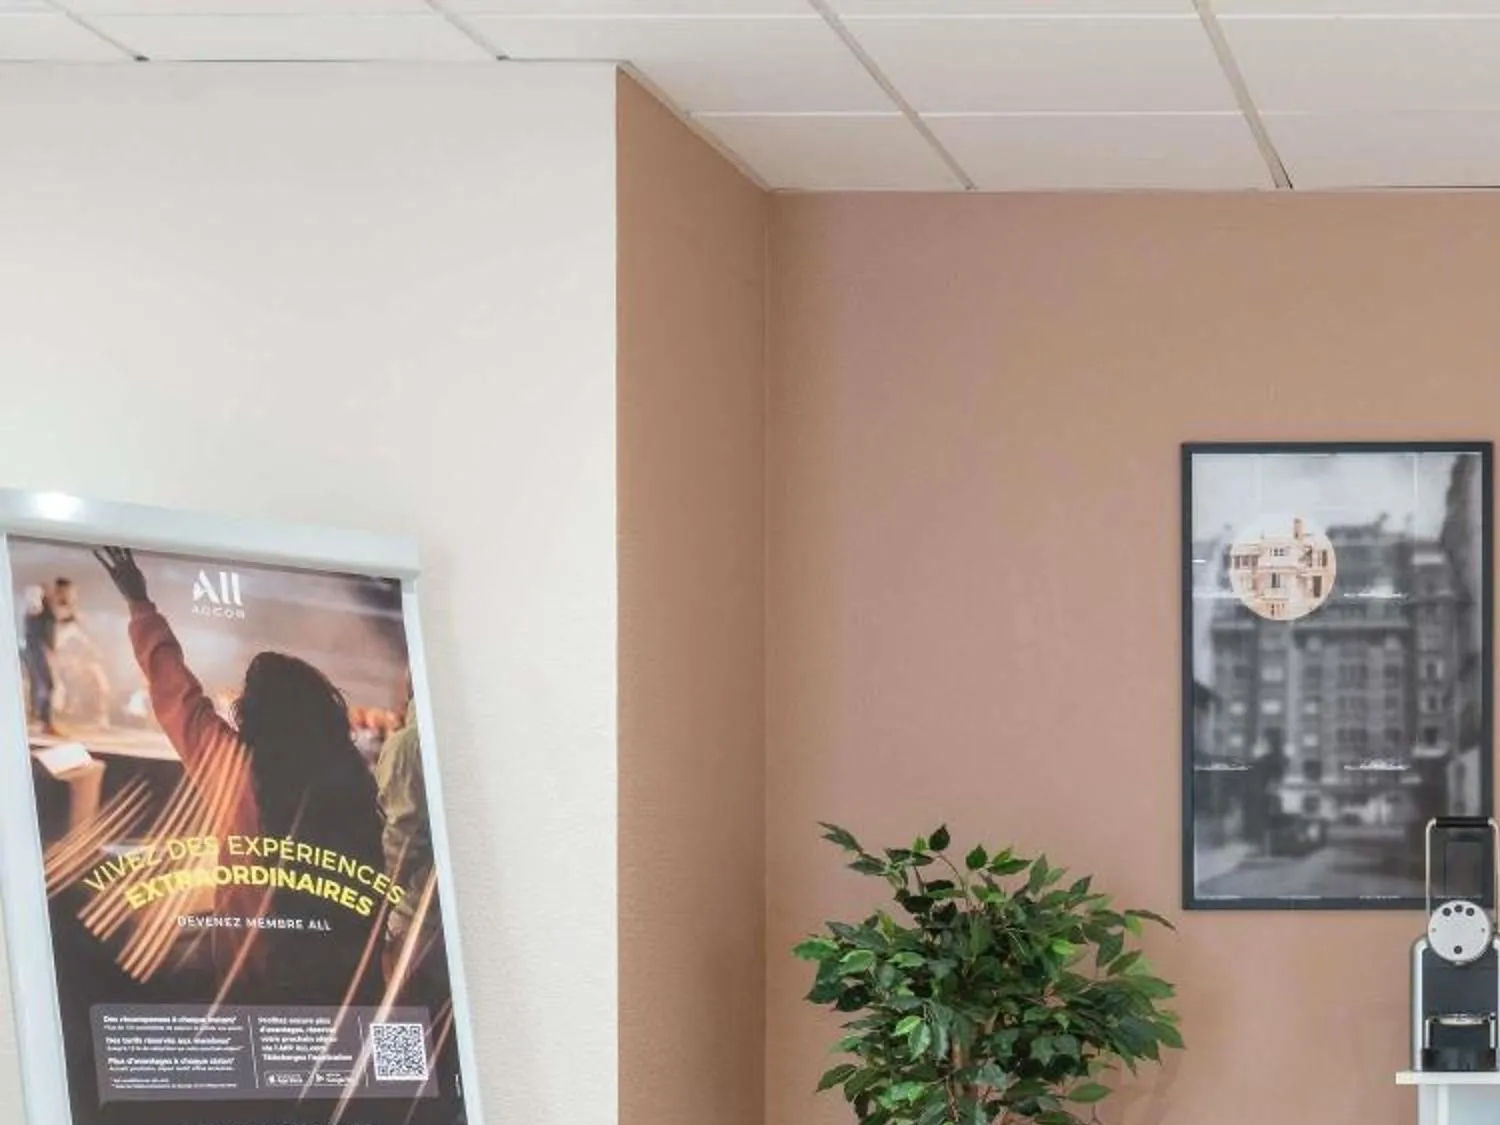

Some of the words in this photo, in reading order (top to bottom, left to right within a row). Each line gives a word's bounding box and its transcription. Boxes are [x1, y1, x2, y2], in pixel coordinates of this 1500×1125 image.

[84, 843, 162, 891] VIVEZ
[168, 836, 219, 860] DES
[227, 835, 405, 905] EXPÉRIENCES
[125, 865, 374, 917] EXTRAORDINAIRES
[177, 915, 242, 929] DEVENEZ
[246, 917, 304, 930] MEMBRE
[308, 918, 333, 931] ALL
